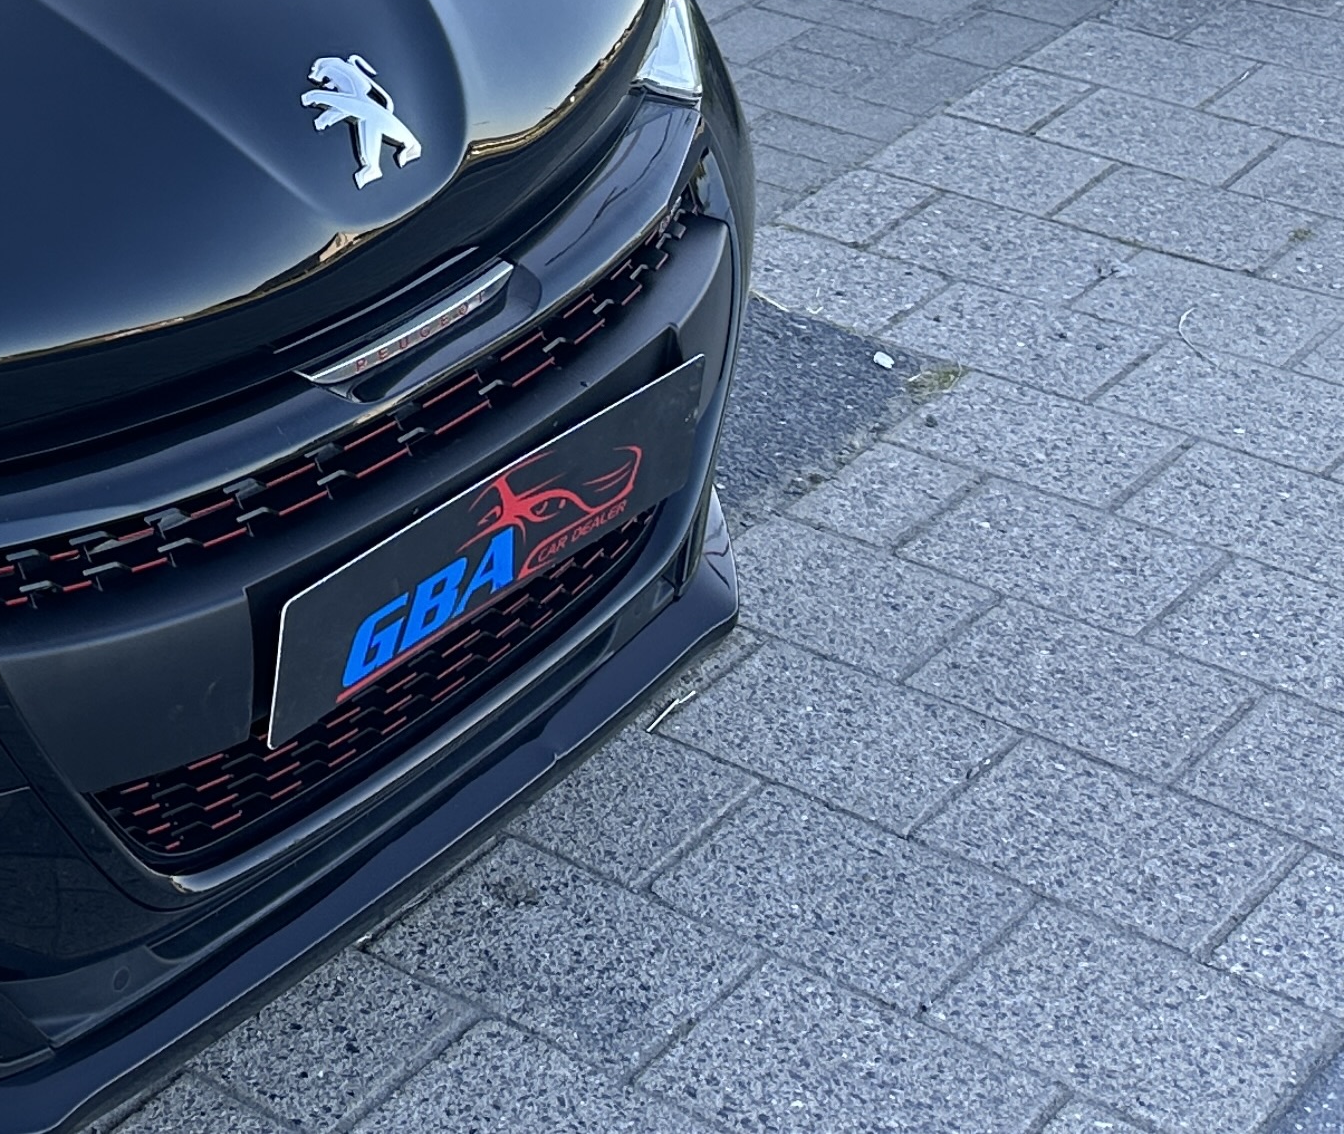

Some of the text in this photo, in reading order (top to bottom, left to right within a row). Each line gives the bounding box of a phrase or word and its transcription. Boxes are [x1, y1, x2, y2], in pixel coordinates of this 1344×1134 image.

[355, 290, 485, 374] PEUGEOT
[538, 498, 628, 563] CAR DEALER
[341, 527, 515, 687] GBA
